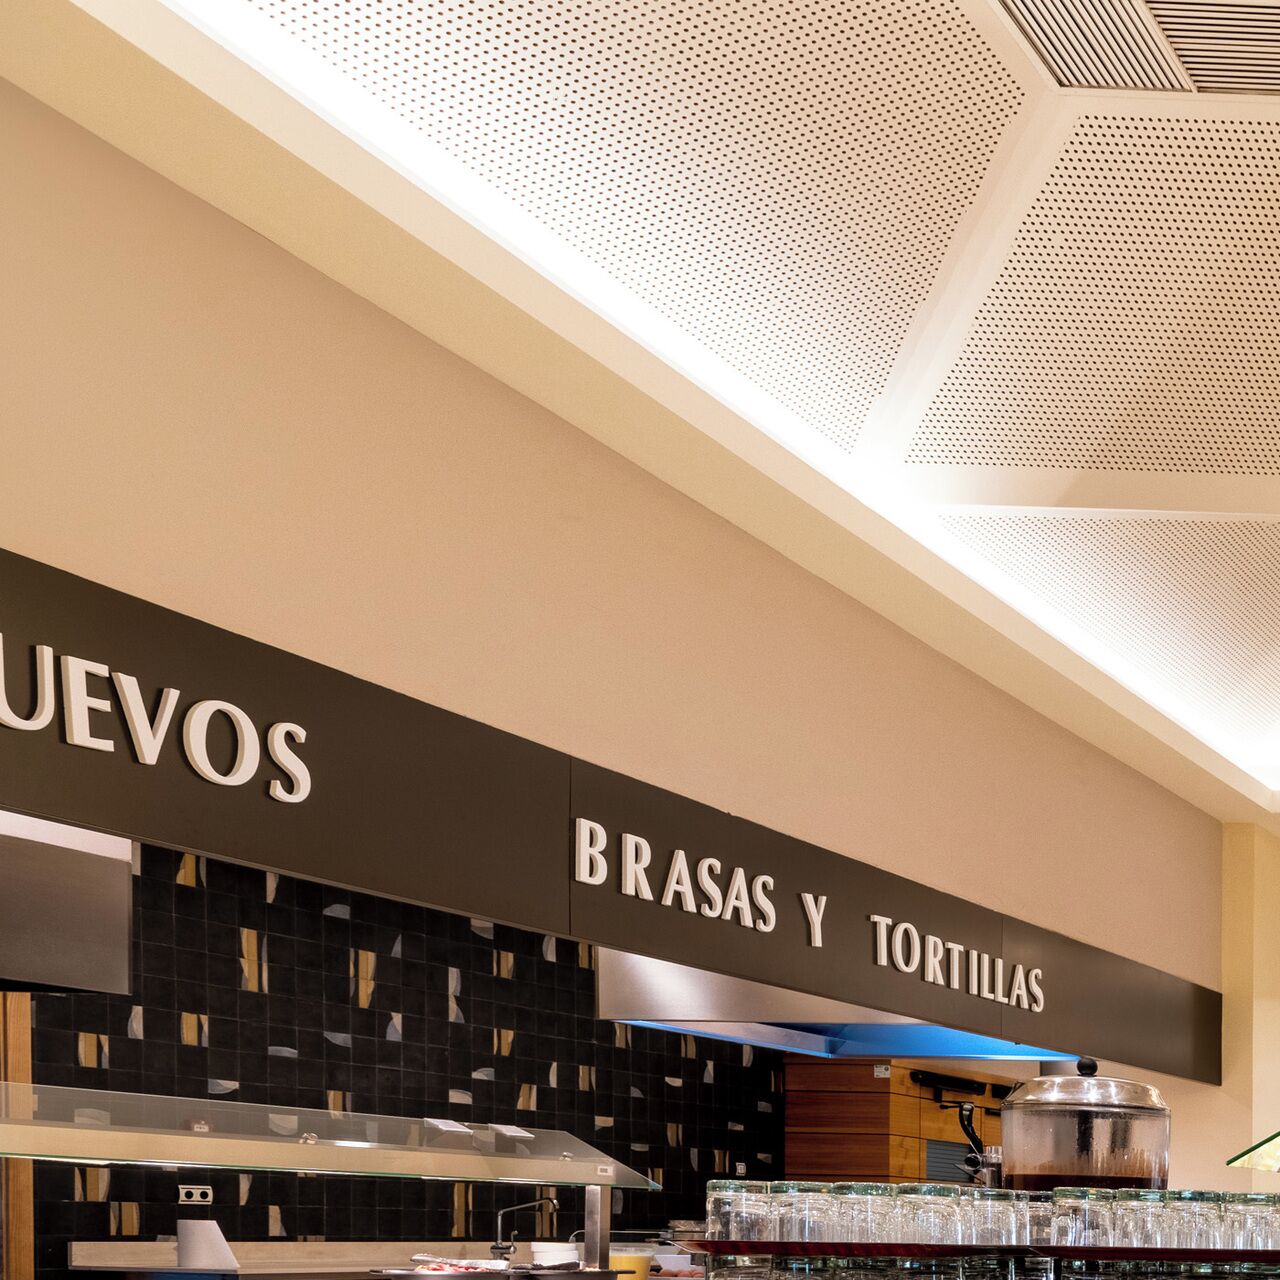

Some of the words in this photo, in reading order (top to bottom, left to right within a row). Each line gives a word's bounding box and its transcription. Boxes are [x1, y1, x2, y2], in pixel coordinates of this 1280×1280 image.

[0, 632, 312, 804] UEVOS
[575, 817, 777, 934] BRASAS
[800, 892, 828, 948] Y
[869, 914, 1045, 1013] TORTILLAS
